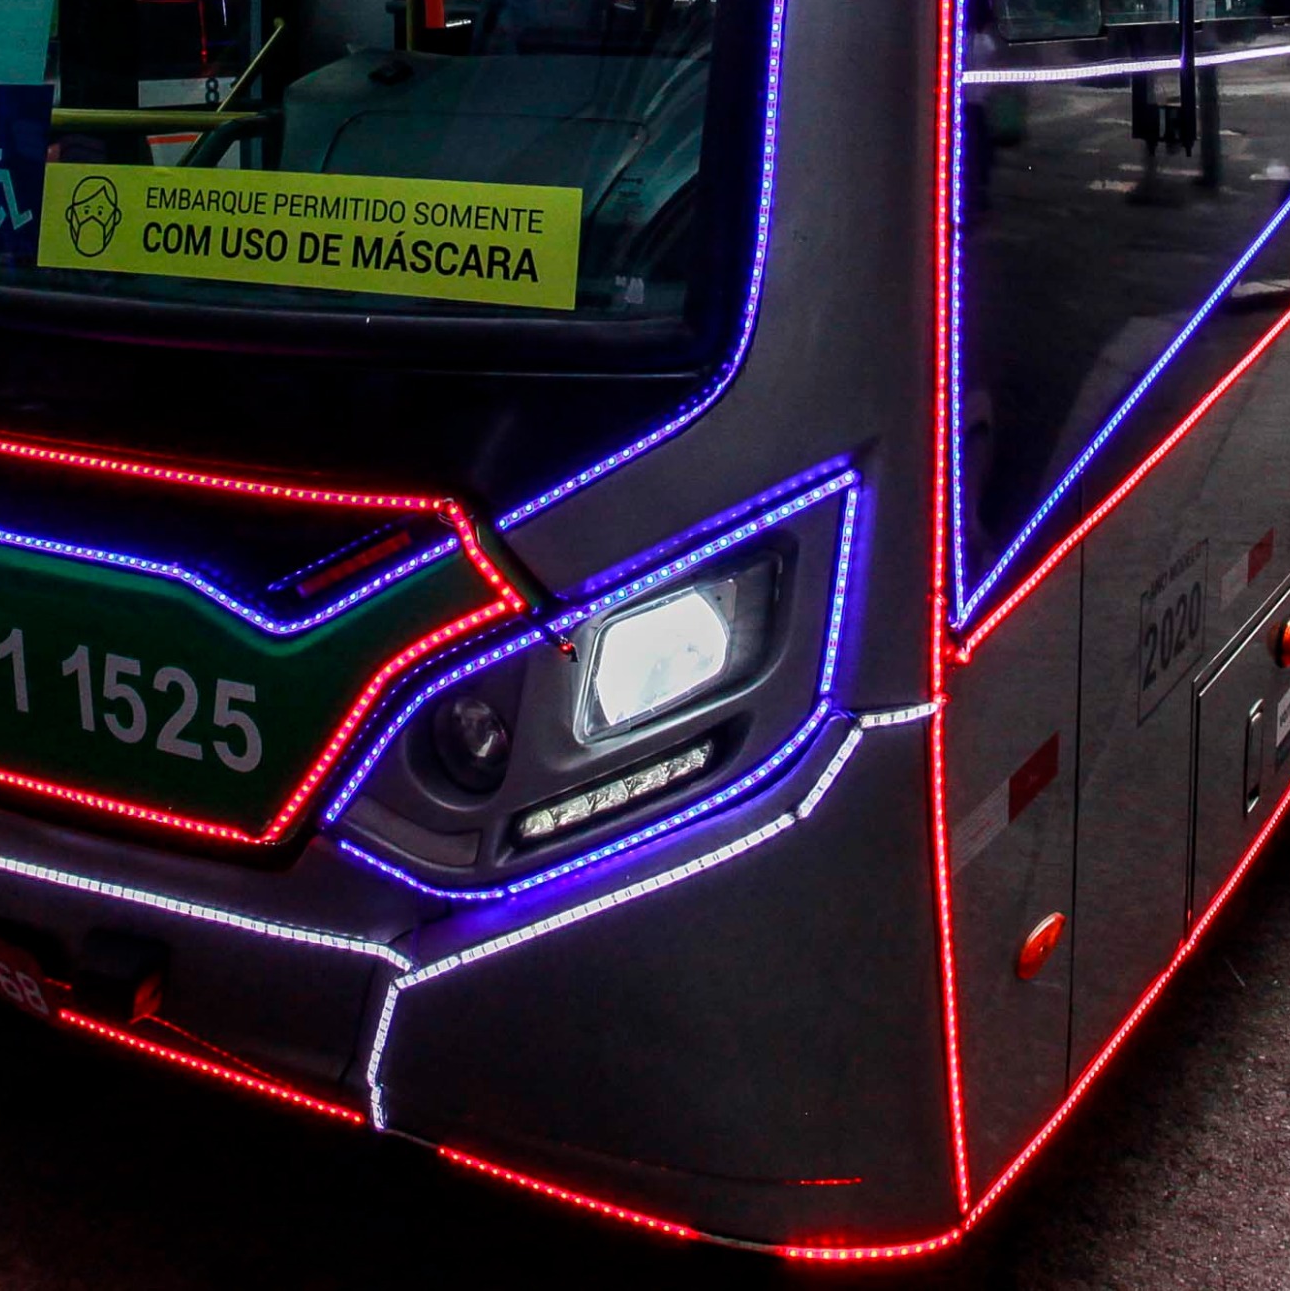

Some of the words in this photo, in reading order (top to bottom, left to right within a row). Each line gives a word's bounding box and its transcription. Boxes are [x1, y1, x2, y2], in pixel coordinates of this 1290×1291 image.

[142, 222, 212, 257] COM
[220, 226, 288, 263] USO
[298, 232, 341, 267] DE
[352, 229, 540, 285] MÁSCARA
[145, 187, 267, 217] EMBARQUE
[271, 195, 406, 225] PERMITIDO
[412, 201, 544, 234] SOMENTE
[1142, 580, 1202, 693] 2020
[61, 643, 264, 774] 1525
